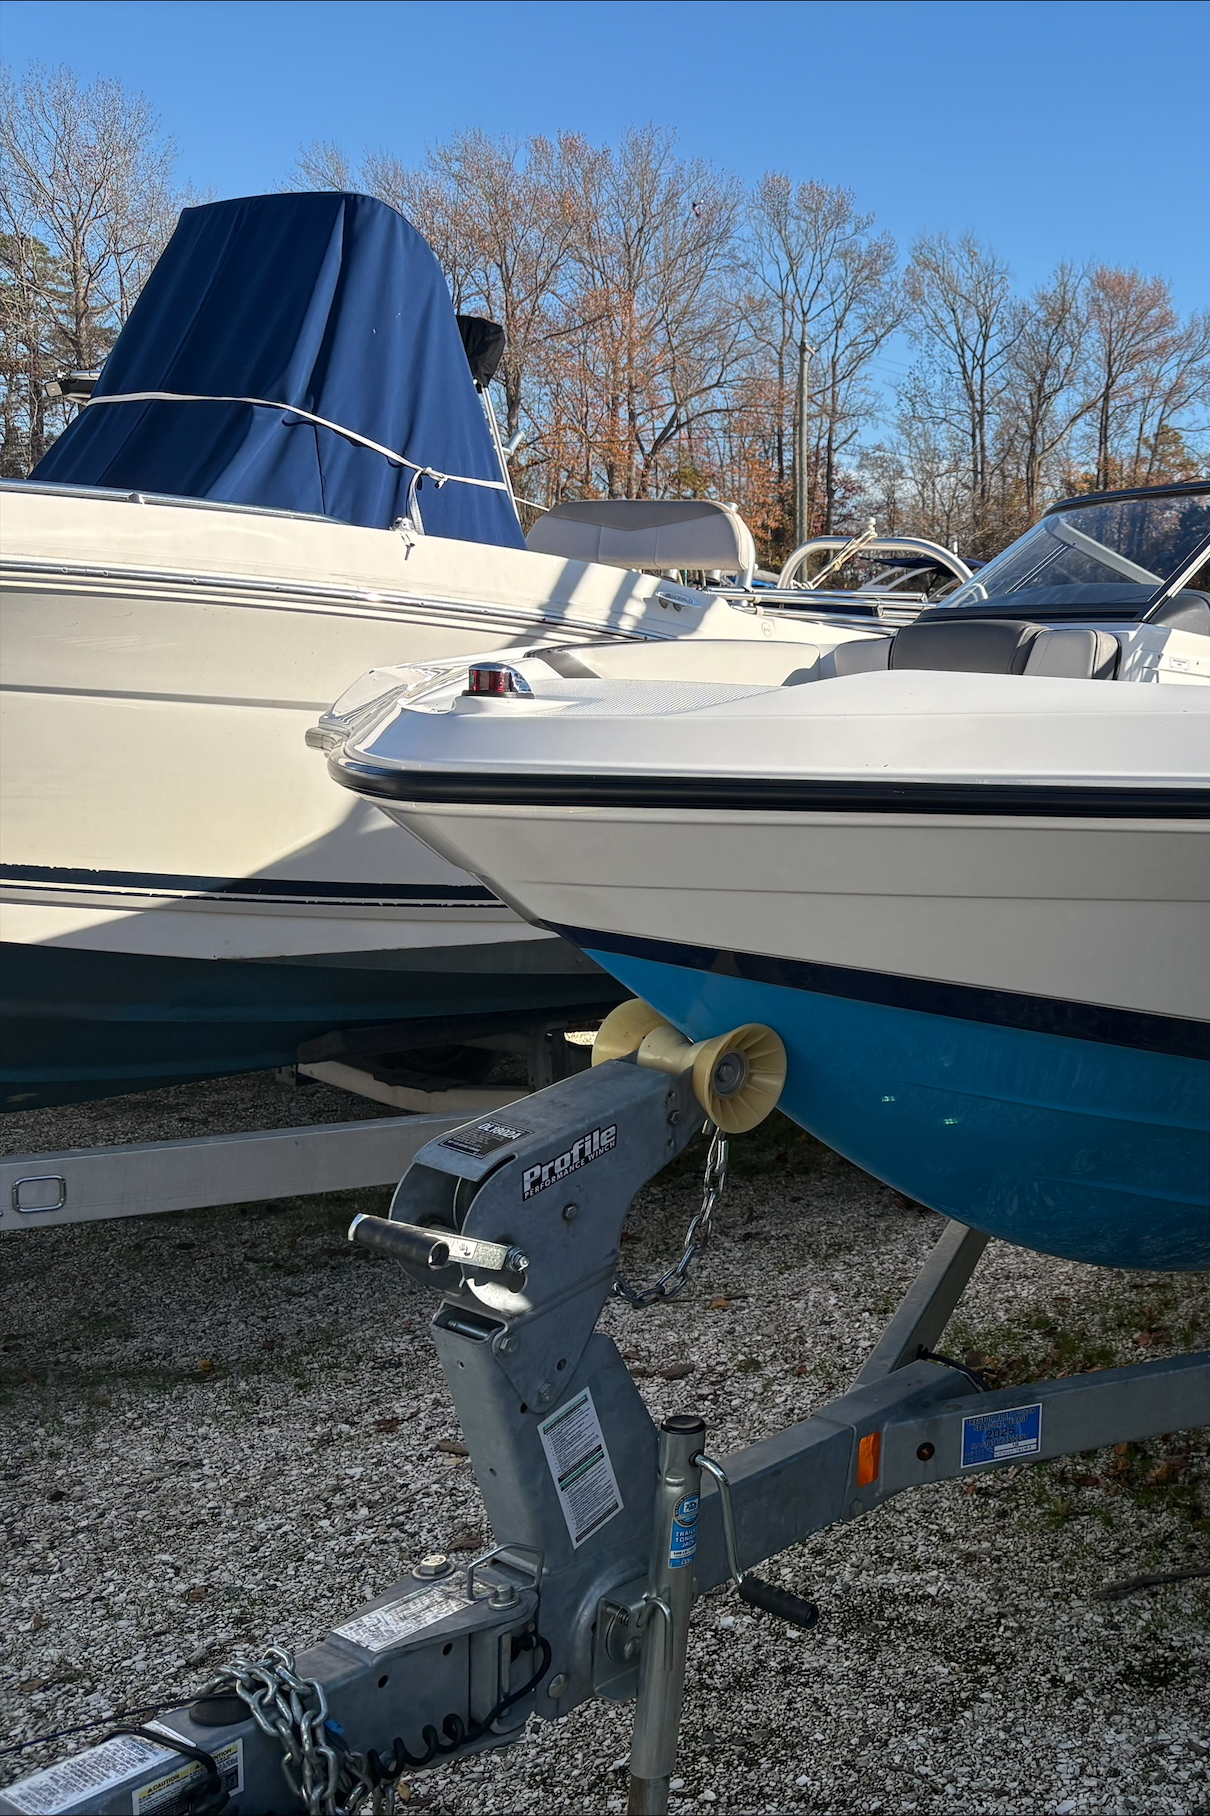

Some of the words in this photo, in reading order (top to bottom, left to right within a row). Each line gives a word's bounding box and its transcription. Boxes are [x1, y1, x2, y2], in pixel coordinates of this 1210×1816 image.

[523, 1125, 616, 1193] Profile
[524, 1158, 586, 1200] PERFORMANCE
[588, 1140, 616, 1162] WINCH
[985, 1425, 1015, 1440] 2025
[152, 1773, 180, 1791] CAUTION
